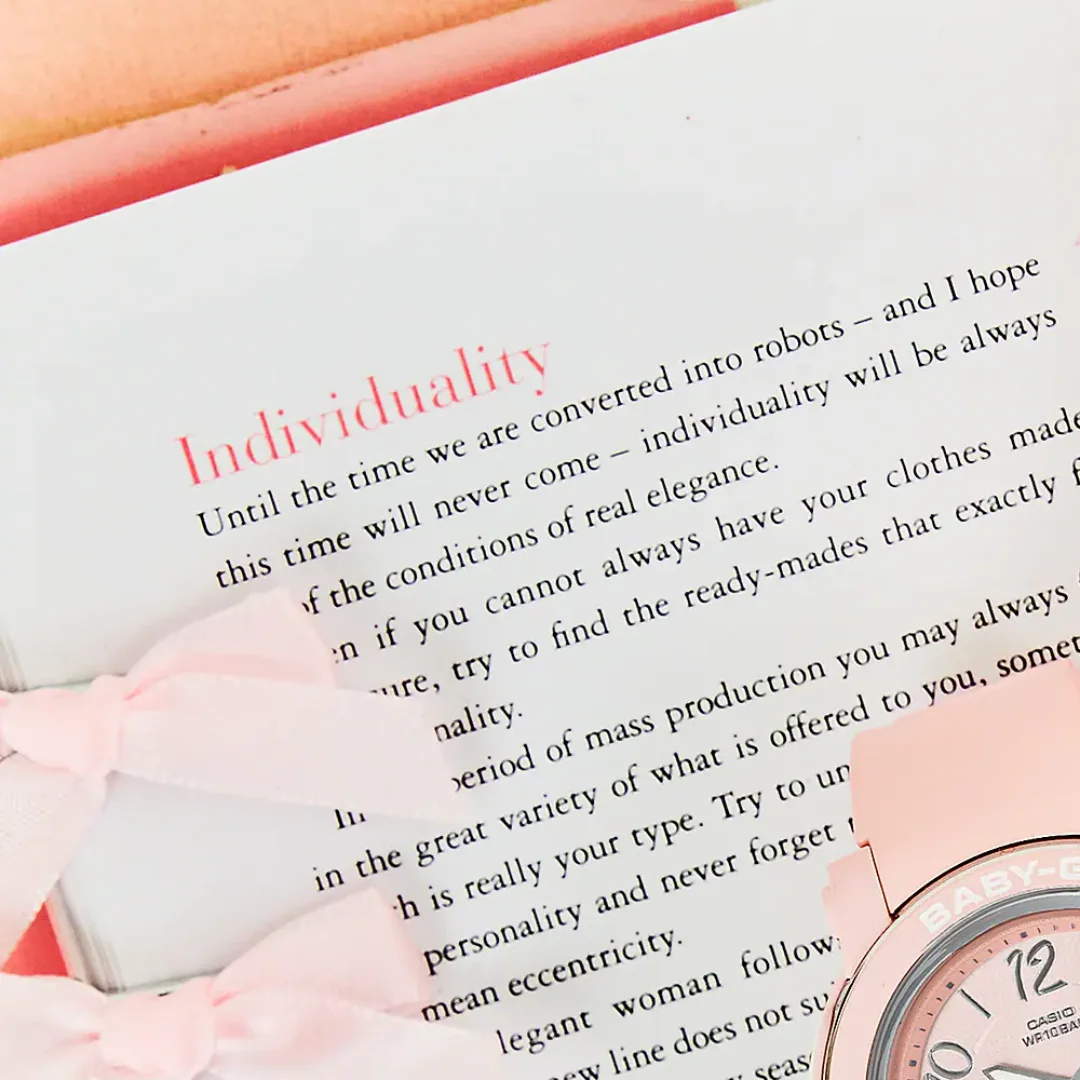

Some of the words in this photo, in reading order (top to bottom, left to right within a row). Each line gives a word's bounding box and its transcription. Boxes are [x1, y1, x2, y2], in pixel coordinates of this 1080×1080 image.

[175, 342, 551, 487] Individuality
[196, 489, 282, 537] Until
[290, 478, 338, 509] the
[347, 455, 416, 490] time
[425, 439, 467, 464] we
[476, 422, 520, 450] are
[530, 364, 674, 433] converted
[681, 352, 743, 386] into
[753, 319, 845, 363] robots
[882, 281, 937, 322] and
[944, 274, 960, 302] I
[966, 258, 1040, 295] hope
[215, 553, 272, 589] this
[282, 531, 352, 567] time
[362, 500, 422, 540] will
[433, 479, 511, 520] never
[524, 452, 601, 490] come
[640, 379, 830, 454] individuality
[843, 348, 902, 388] will
[910, 340, 948, 368] be
[960, 309, 1058, 354] always
[373, 616, 398, 650] if
[412, 606, 470, 646] you
[485, 568, 586, 615] cannot
[601, 532, 702, 578] always
[714, 506, 785, 542] have
[800, 479, 868, 524] your
[886, 442, 992, 488] clothes
[450, 652, 492, 682] try
[508, 640, 539, 663] to
[551, 608, 610, 650] find
[622, 596, 670, 627] the
[684, 535, 869, 608] ready-mades
[881, 512, 942, 546] that
[954, 472, 1056, 523] exactly
[546, 728, 574, 763] of
[584, 714, 656, 751] mass
[664, 661, 827, 734] production
[836, 641, 890, 680] you
[900, 618, 960, 652] may
[971, 584, 1069, 630] always
[312, 866, 346, 892] in
[355, 848, 404, 878] the
[415, 822, 489, 868] great
[498, 786, 597, 832] variety
[610, 762, 639, 798] of
[649, 748, 724, 784] what
[732, 734, 760, 760] is
[769, 693, 870, 748] offered
[880, 690, 912, 713] to
[922, 669, 988, 708] you,
[420, 986, 500, 1022] mean
[508, 929, 683, 998] eccentricity.
[1006, 939, 1068, 1002] 12
[1026, 1006, 1077, 1031] CASIO
